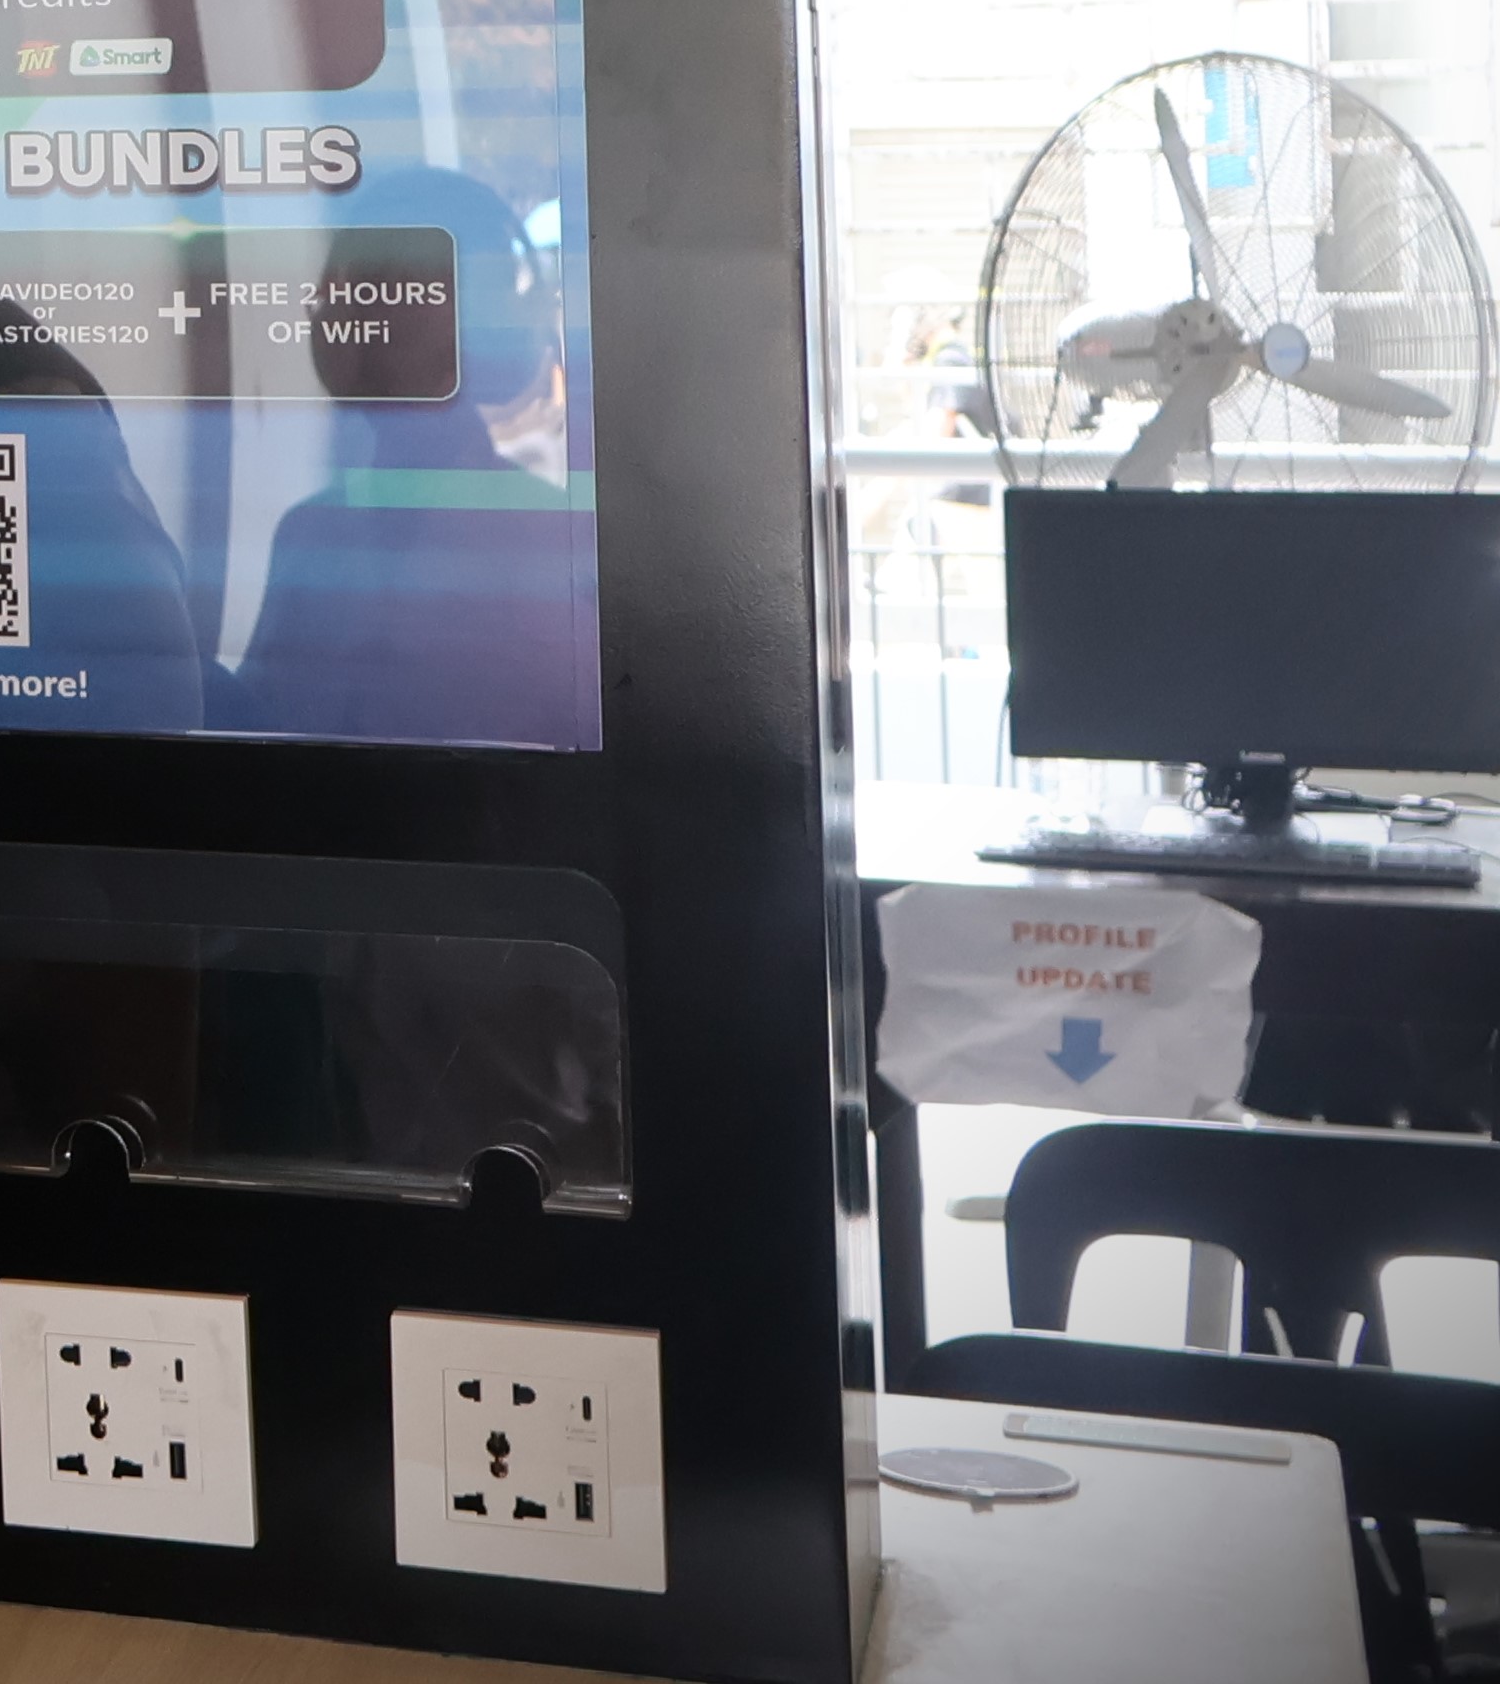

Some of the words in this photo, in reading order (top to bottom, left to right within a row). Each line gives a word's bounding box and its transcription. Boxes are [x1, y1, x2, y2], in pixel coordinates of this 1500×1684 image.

[16, 44, 60, 74] TNT
[102, 47, 163, 66] Smart
[5, 126, 362, 200] BUNDLES
[210, 282, 288, 304] FREE
[300, 282, 319, 305] 2
[329, 282, 447, 305] HOURS
[33, 307, 55, 320] or
[268, 321, 312, 343] OF
[321, 320, 390, 344] WiFi
[1011, 920, 1156, 951] PROFILE
[1015, 966, 1152, 995] UPDATE
